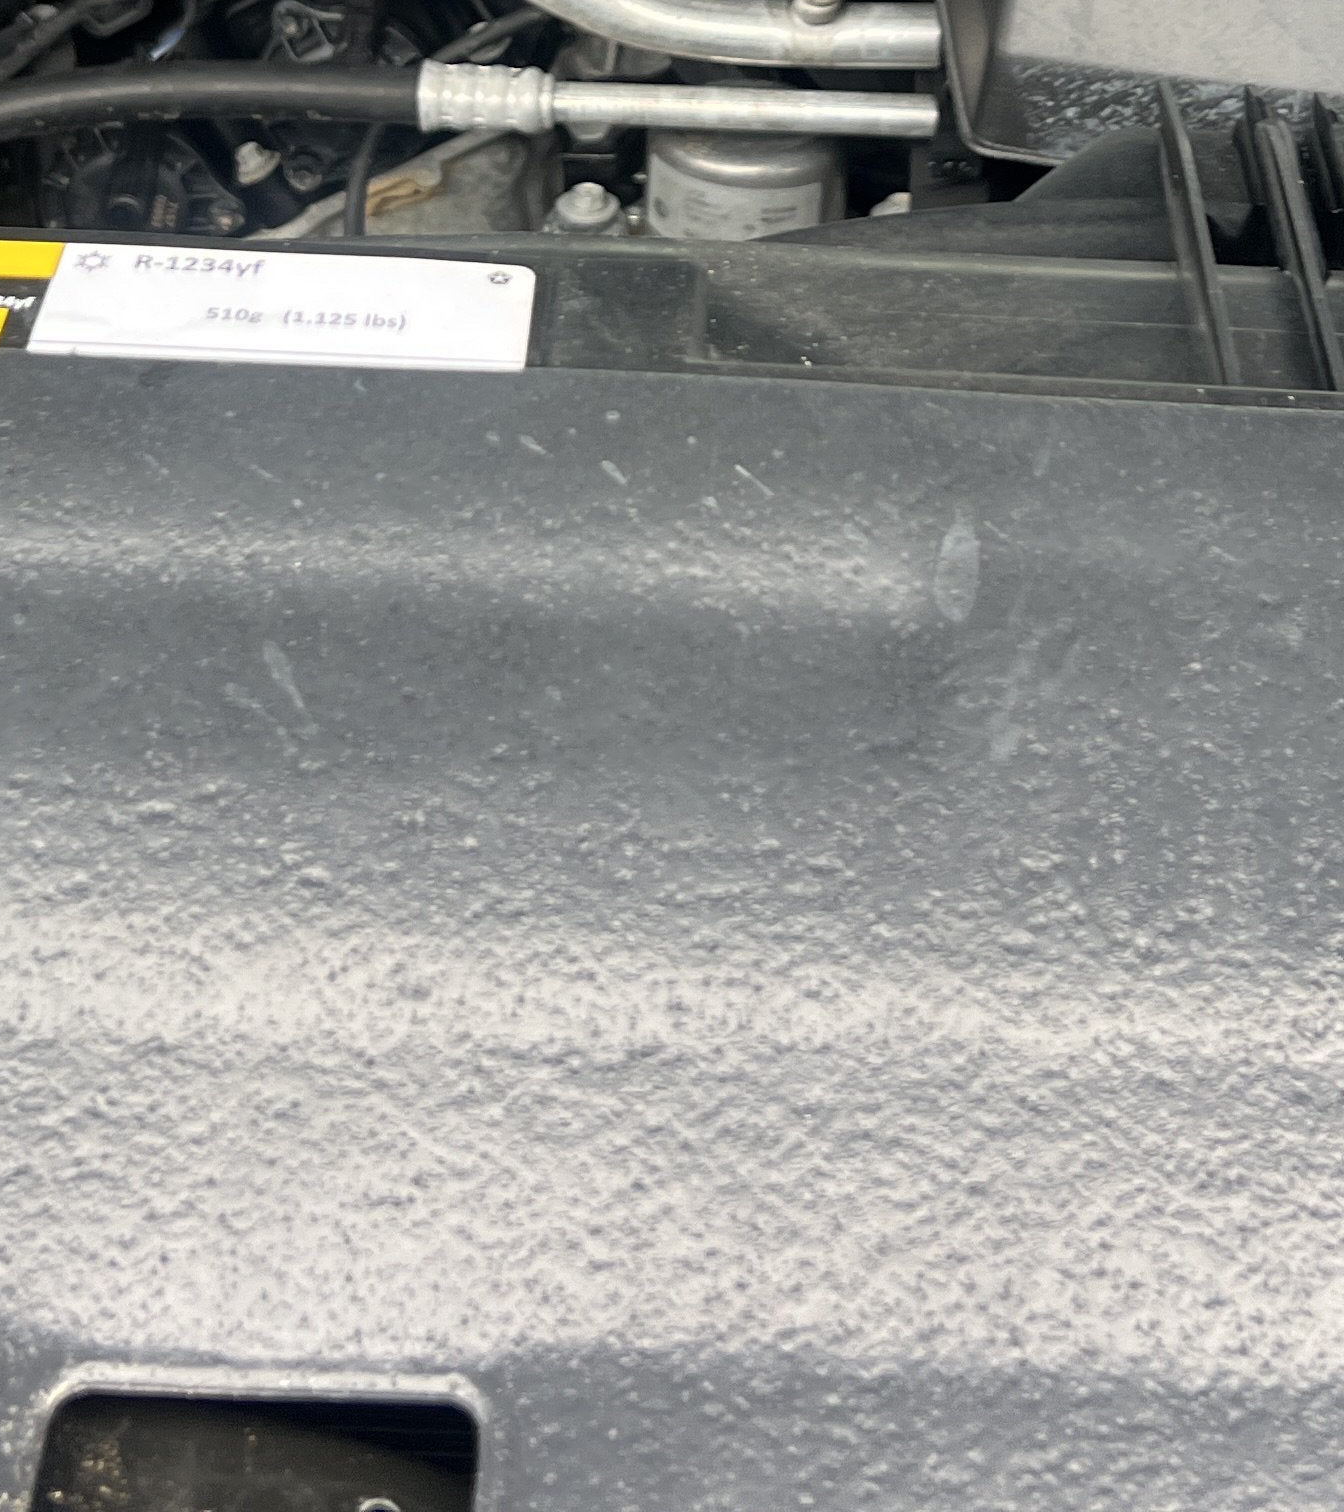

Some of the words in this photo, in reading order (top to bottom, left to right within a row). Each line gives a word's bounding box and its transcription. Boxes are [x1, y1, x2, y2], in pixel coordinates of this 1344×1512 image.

[134, 254, 266, 277] R-1234yf
[206, 306, 264, 324] 510g
[283, 308, 358, 326] (1.125
[364, 311, 407, 331] lbs)
